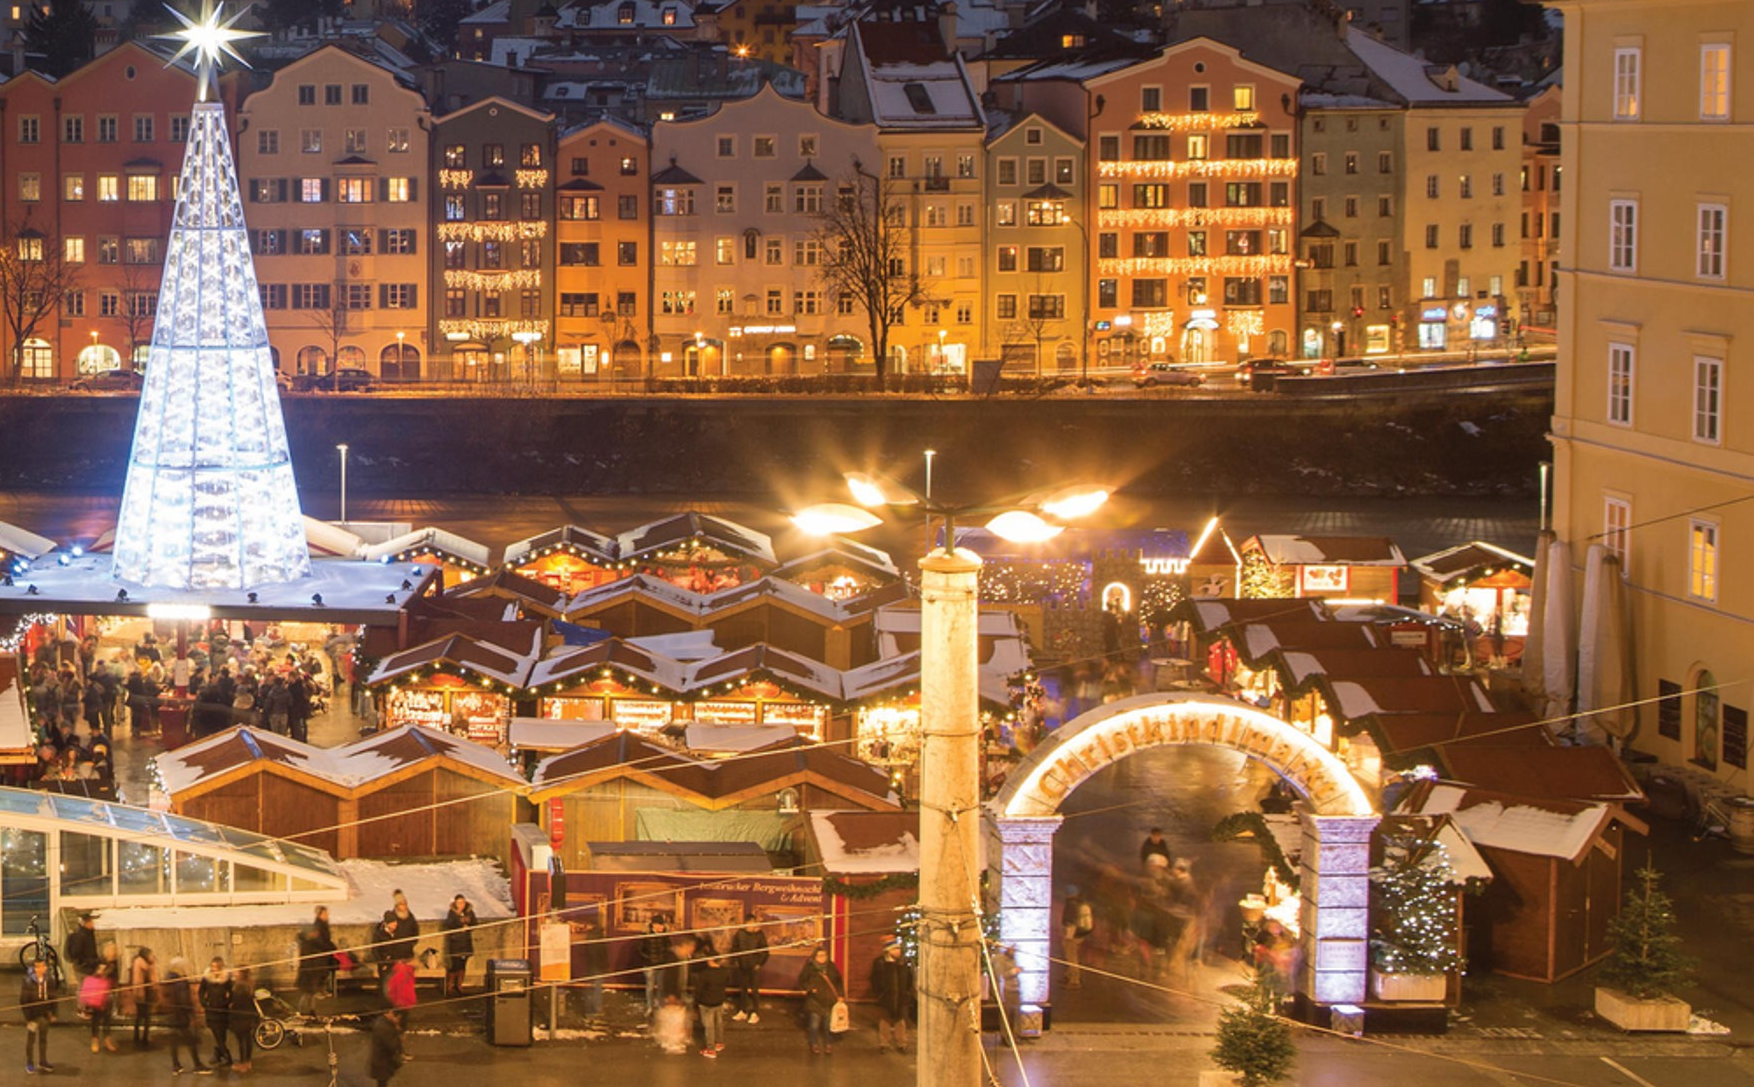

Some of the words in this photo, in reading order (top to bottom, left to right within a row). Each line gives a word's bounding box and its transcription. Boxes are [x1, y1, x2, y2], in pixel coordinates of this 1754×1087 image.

[1037, 712, 1337, 800] Christkindlmarkt
[753, 882, 822, 894] Bergweihnacht
[790, 895, 822, 903] Advent
